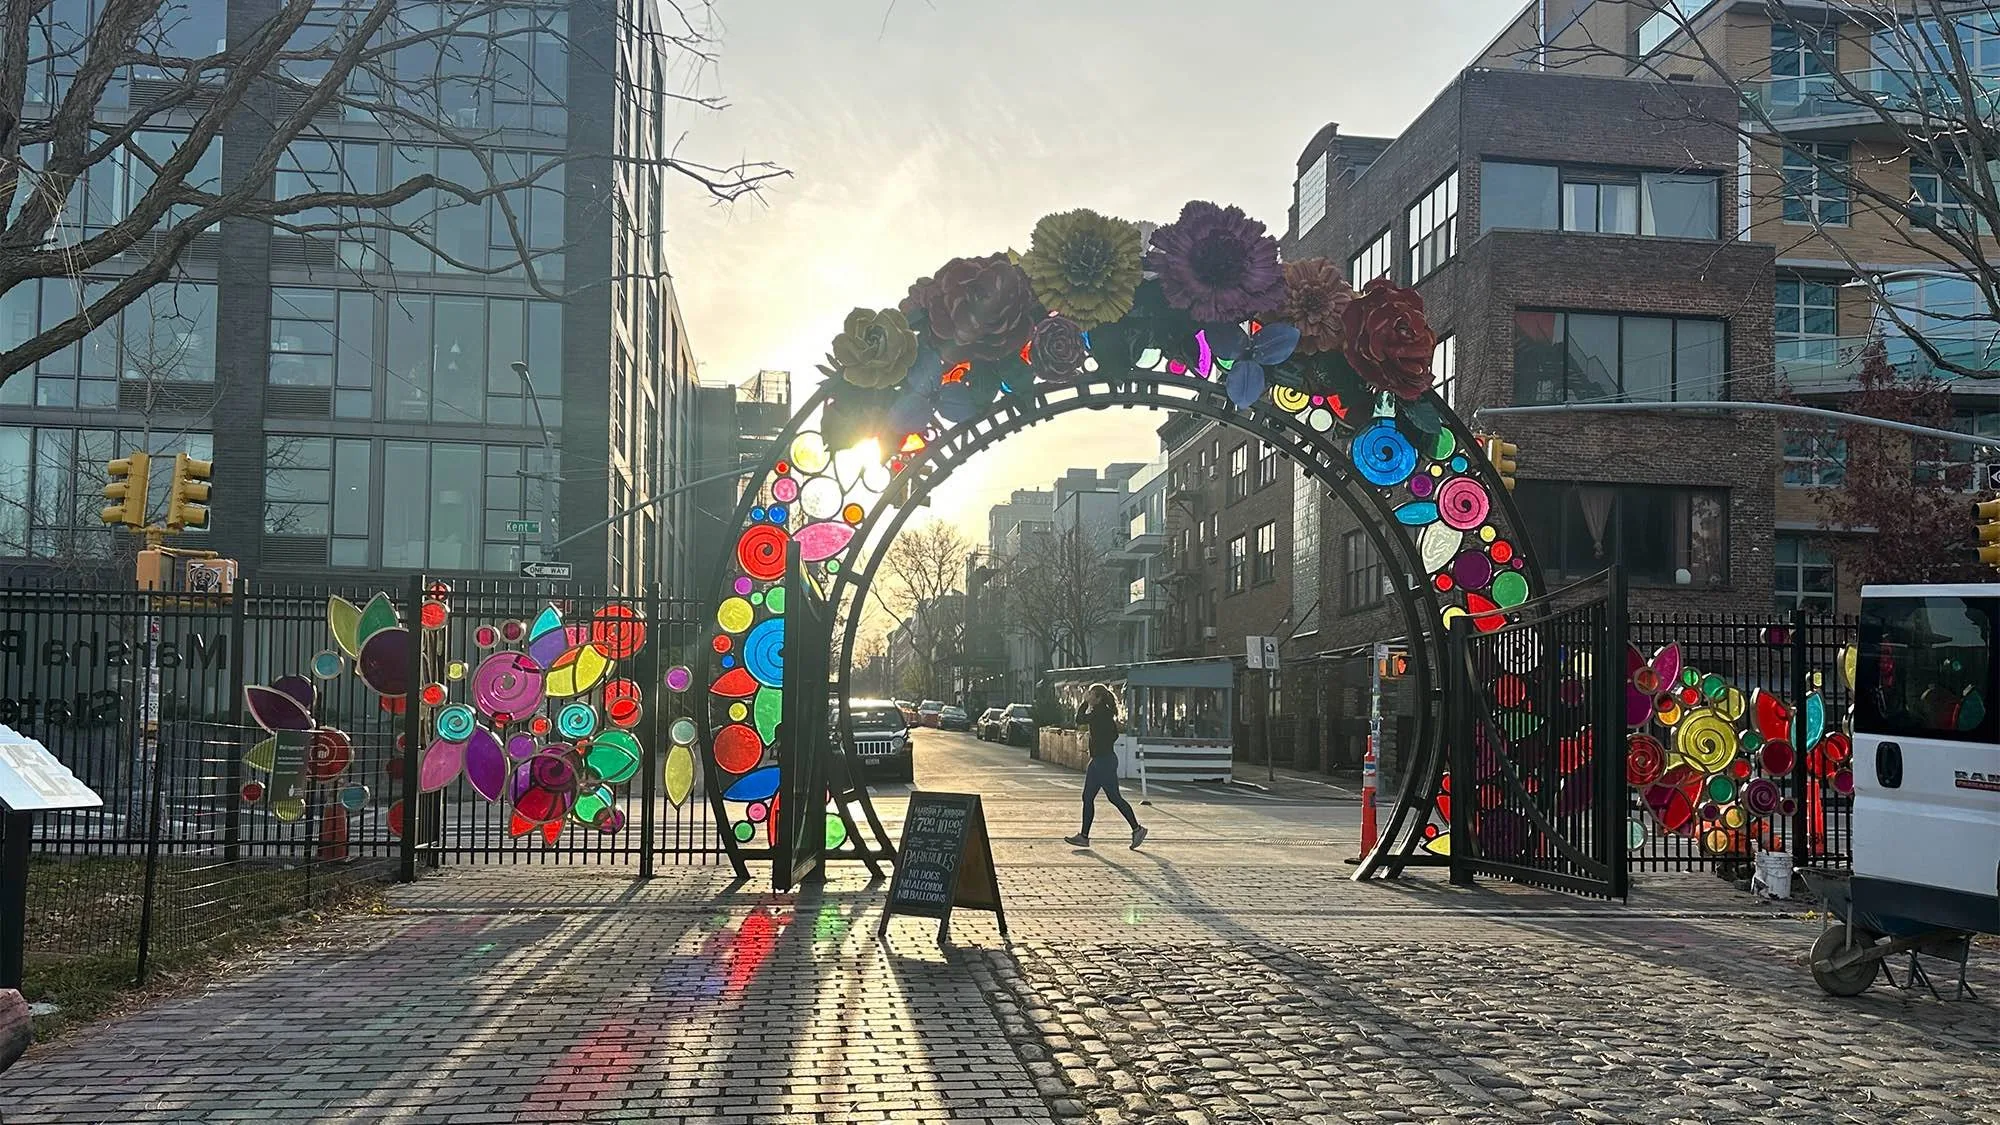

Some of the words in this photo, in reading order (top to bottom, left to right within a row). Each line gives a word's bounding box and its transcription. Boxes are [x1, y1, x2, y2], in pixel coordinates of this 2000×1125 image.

[507, 523, 528, 532] Kent
[908, 869, 919, 879] NO
[920, 871, 940, 881] DOGS
[900, 879, 911, 890] NO
[911, 880, 944, 892] ALCOHOL
[897, 889, 910, 899] NO
[910, 890, 947, 903] BALLOONS
